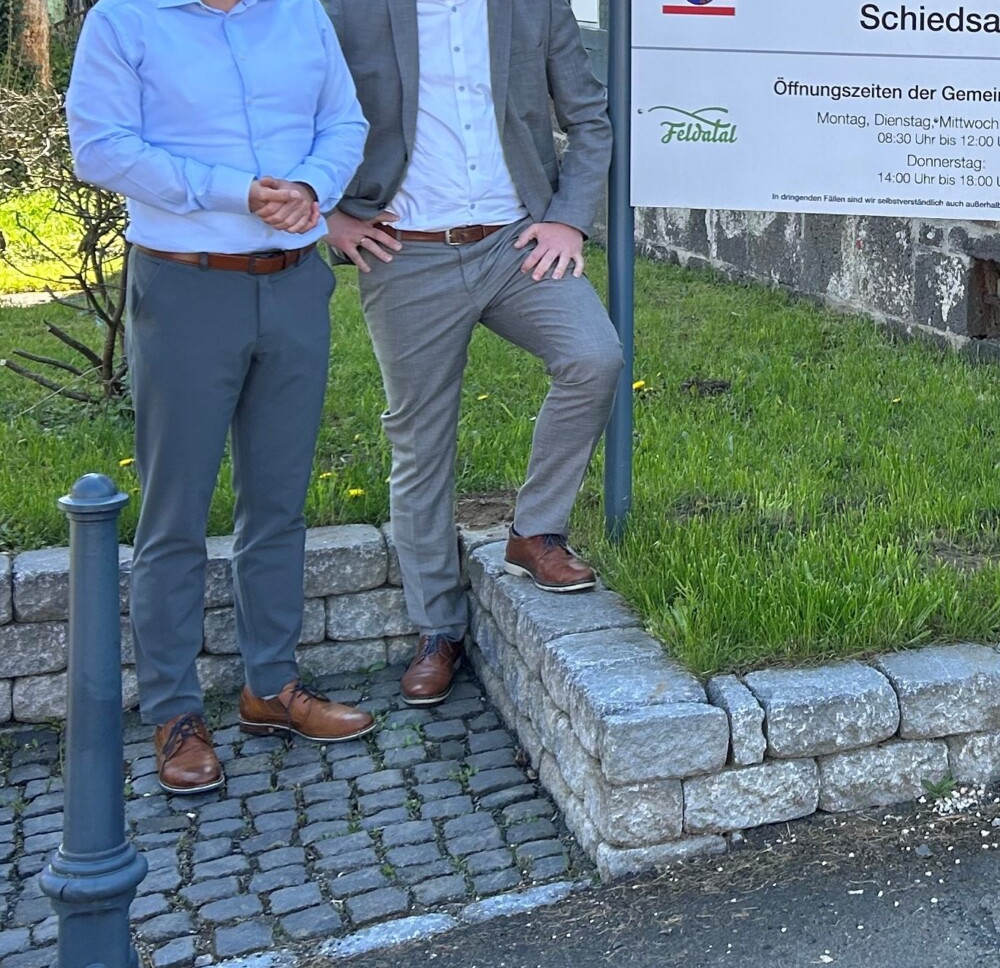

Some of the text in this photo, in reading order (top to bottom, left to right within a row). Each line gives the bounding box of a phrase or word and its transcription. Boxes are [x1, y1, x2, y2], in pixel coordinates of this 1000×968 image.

[774, 77, 902, 100] Öffnungszeiten
[908, 85, 937, 100] der
[818, 112, 869, 128] Montag,
[875, 113, 935, 130] Dienstag,
[939, 116, 999, 129] Mittwoch
[660, 117, 737, 144] Feldatal
[878, 132, 911, 144] 08:30
[915, 134, 936, 144] Uhr
[940, 134, 956, 146] bis
[961, 135, 994, 147] 12:00
[907, 154, 985, 172] Donnerstag:
[878, 172, 910, 184] 14:00
[915, 173, 935, 184] Uhr
[939, 174, 955, 185] bis
[960, 175, 993, 187] 18:00
[772, 192, 779, 200] In
[781, 194, 822, 203] dringenden
[824, 195, 845, 203] Fällen
[847, 196, 863, 204] sind
[878, 198, 943, 207] selbstverständlich
[946, 200, 964, 208] auch
